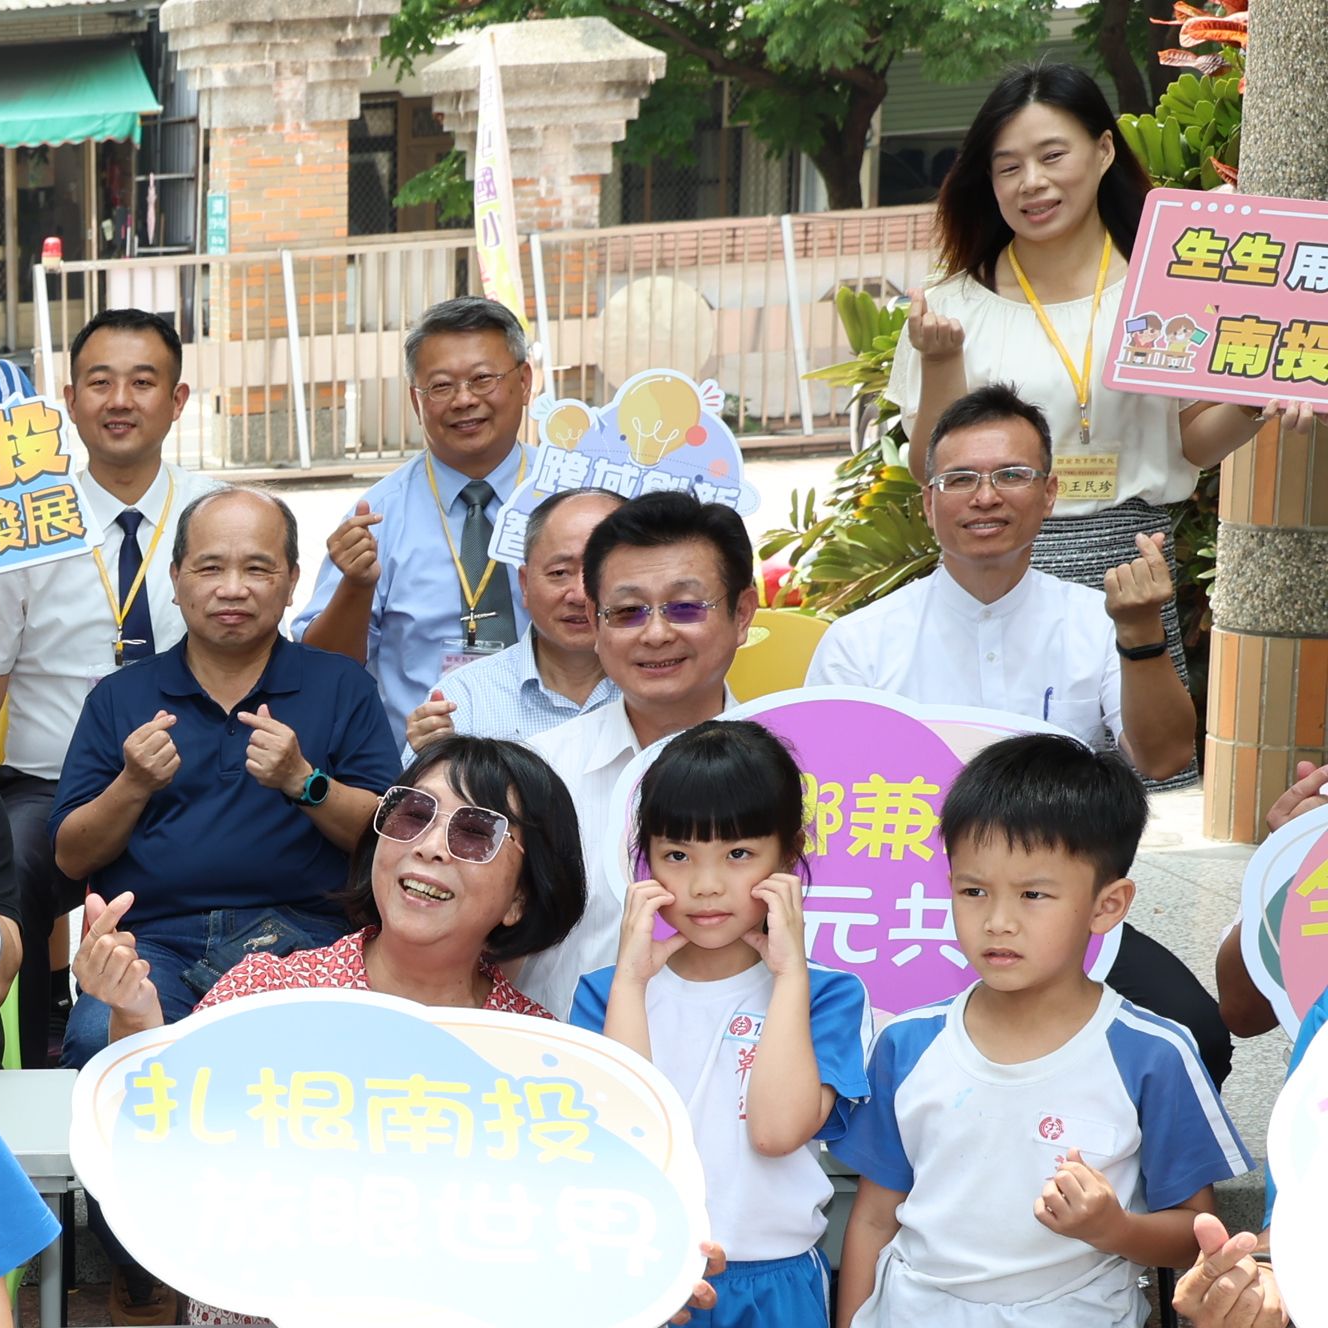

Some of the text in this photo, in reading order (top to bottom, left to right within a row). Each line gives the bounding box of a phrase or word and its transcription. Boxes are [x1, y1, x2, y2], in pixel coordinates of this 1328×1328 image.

[1166, 227, 1328, 294] 生生用
[1207, 315, 1328, 386] 南投
[1069, 480, 1112, 493] 王民珍
[132, 1062, 596, 1164] 扎根南投
